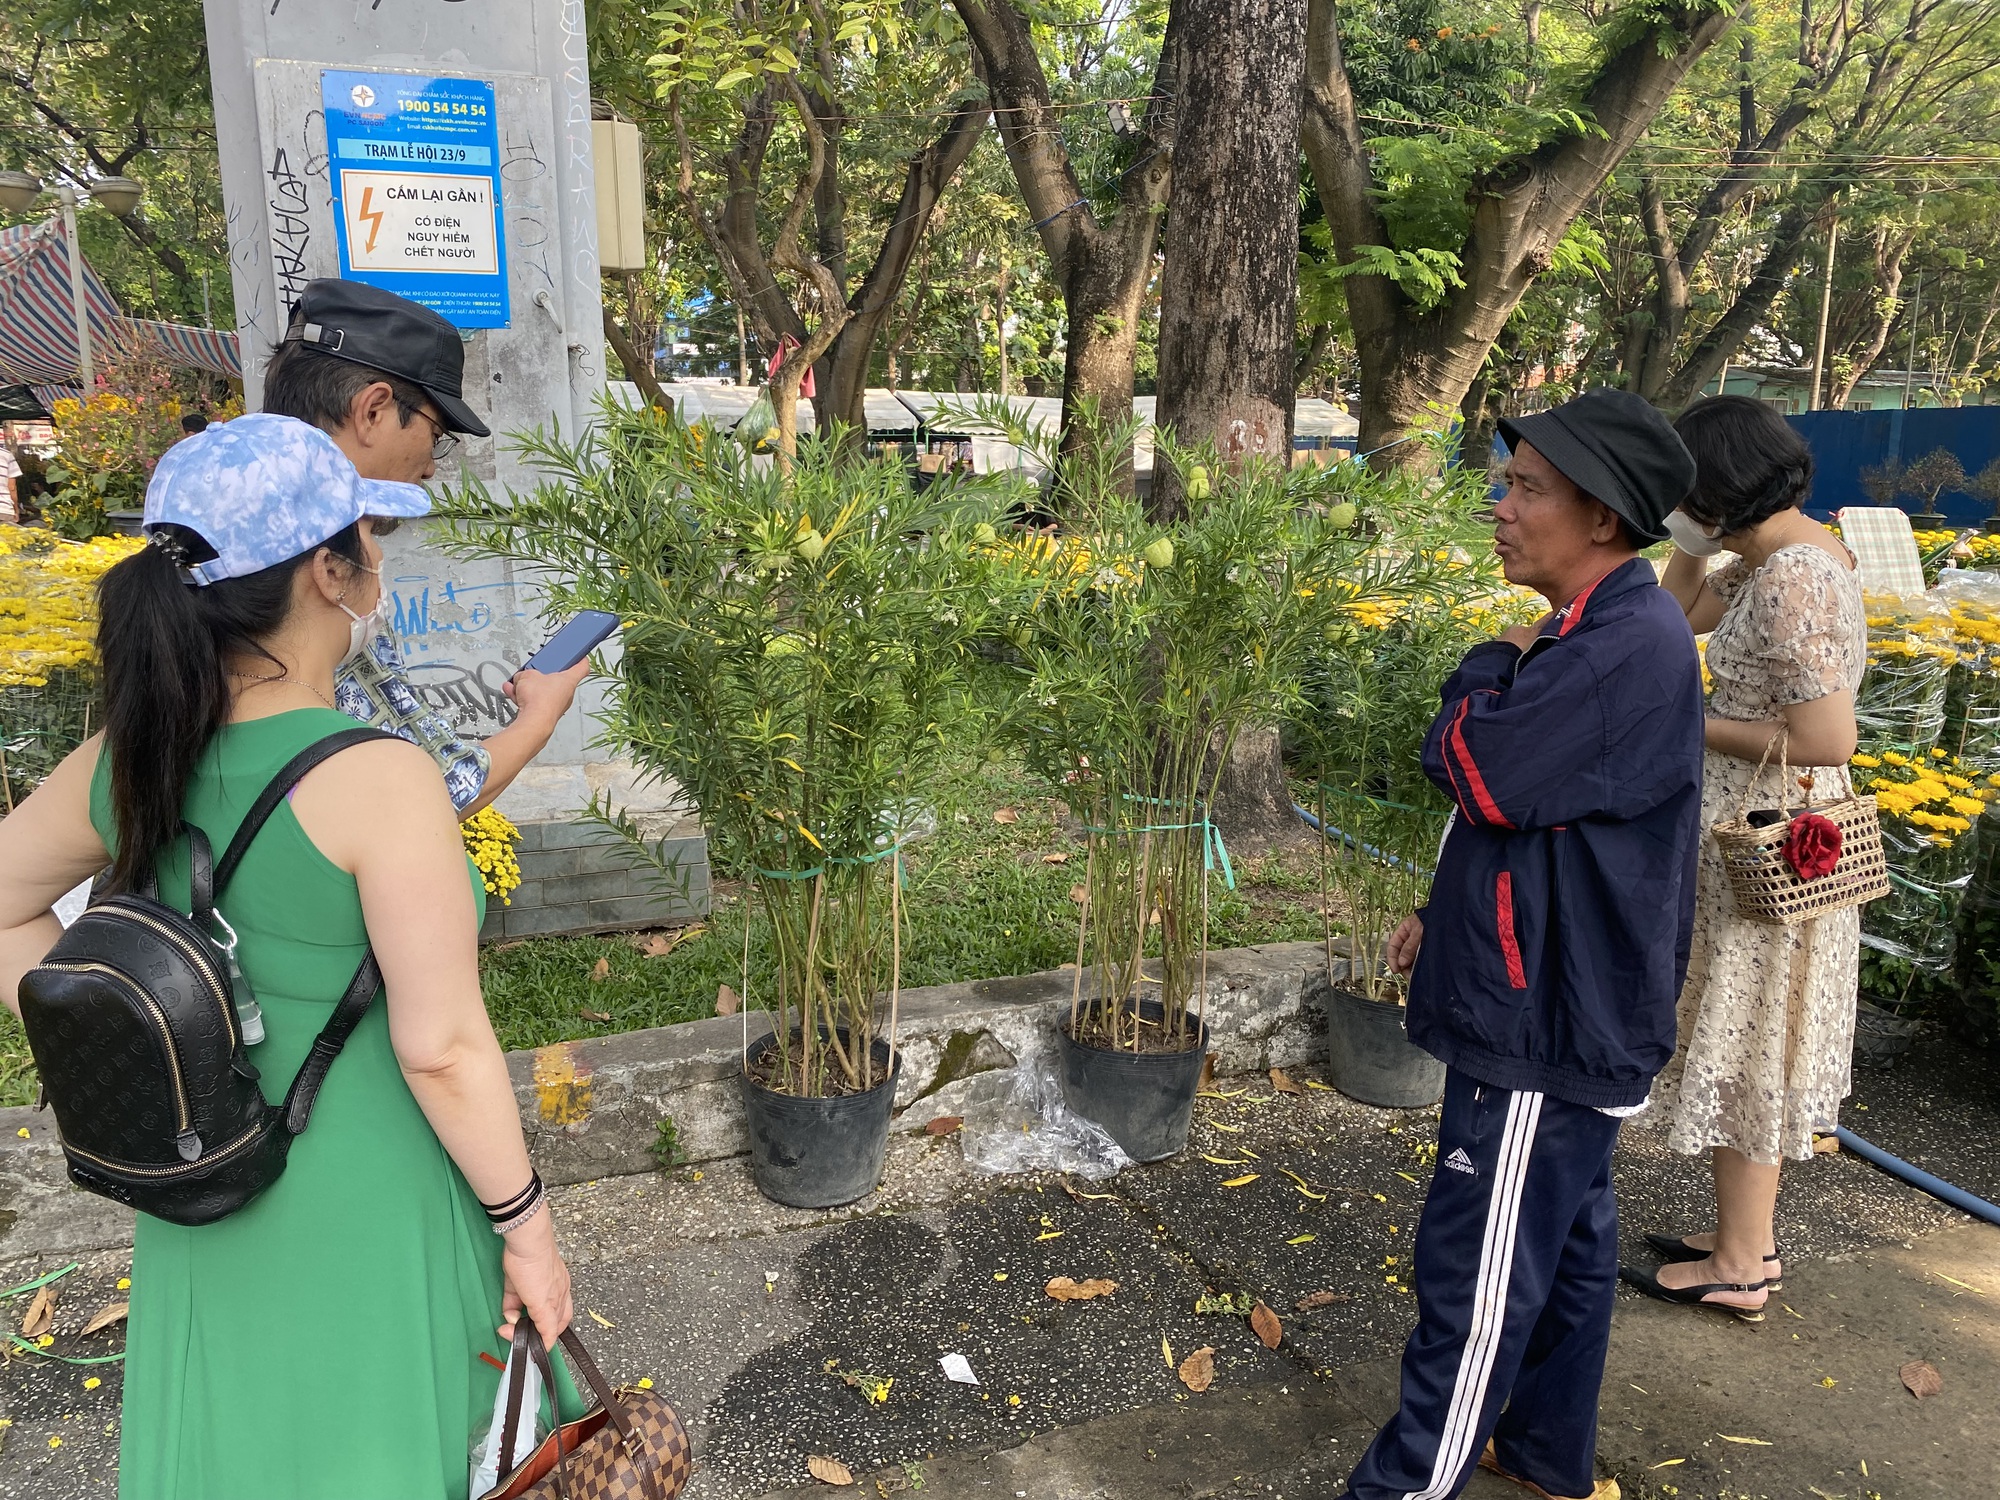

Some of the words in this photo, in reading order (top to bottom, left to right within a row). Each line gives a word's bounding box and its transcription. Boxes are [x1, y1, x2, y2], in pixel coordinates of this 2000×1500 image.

[397, 99, 431, 113] 1900
[433, 101, 450, 114] 54
[452, 103, 468, 115] 54
[470, 104, 487, 117] 54
[364, 143, 398, 161] TRẠM
[401, 142, 415, 159] LỄ
[417, 145, 438, 163] HỘI
[440, 148, 466, 162] 23/9
[386, 185, 418, 200] CẤM
[422, 189, 443, 204] LẠI
[414, 215, 431, 227] CÓ
[434, 215, 461, 229] ĐIỆN
[407, 232, 440, 242] NGUY
[438, 247, 476, 258] NGƯỜI
